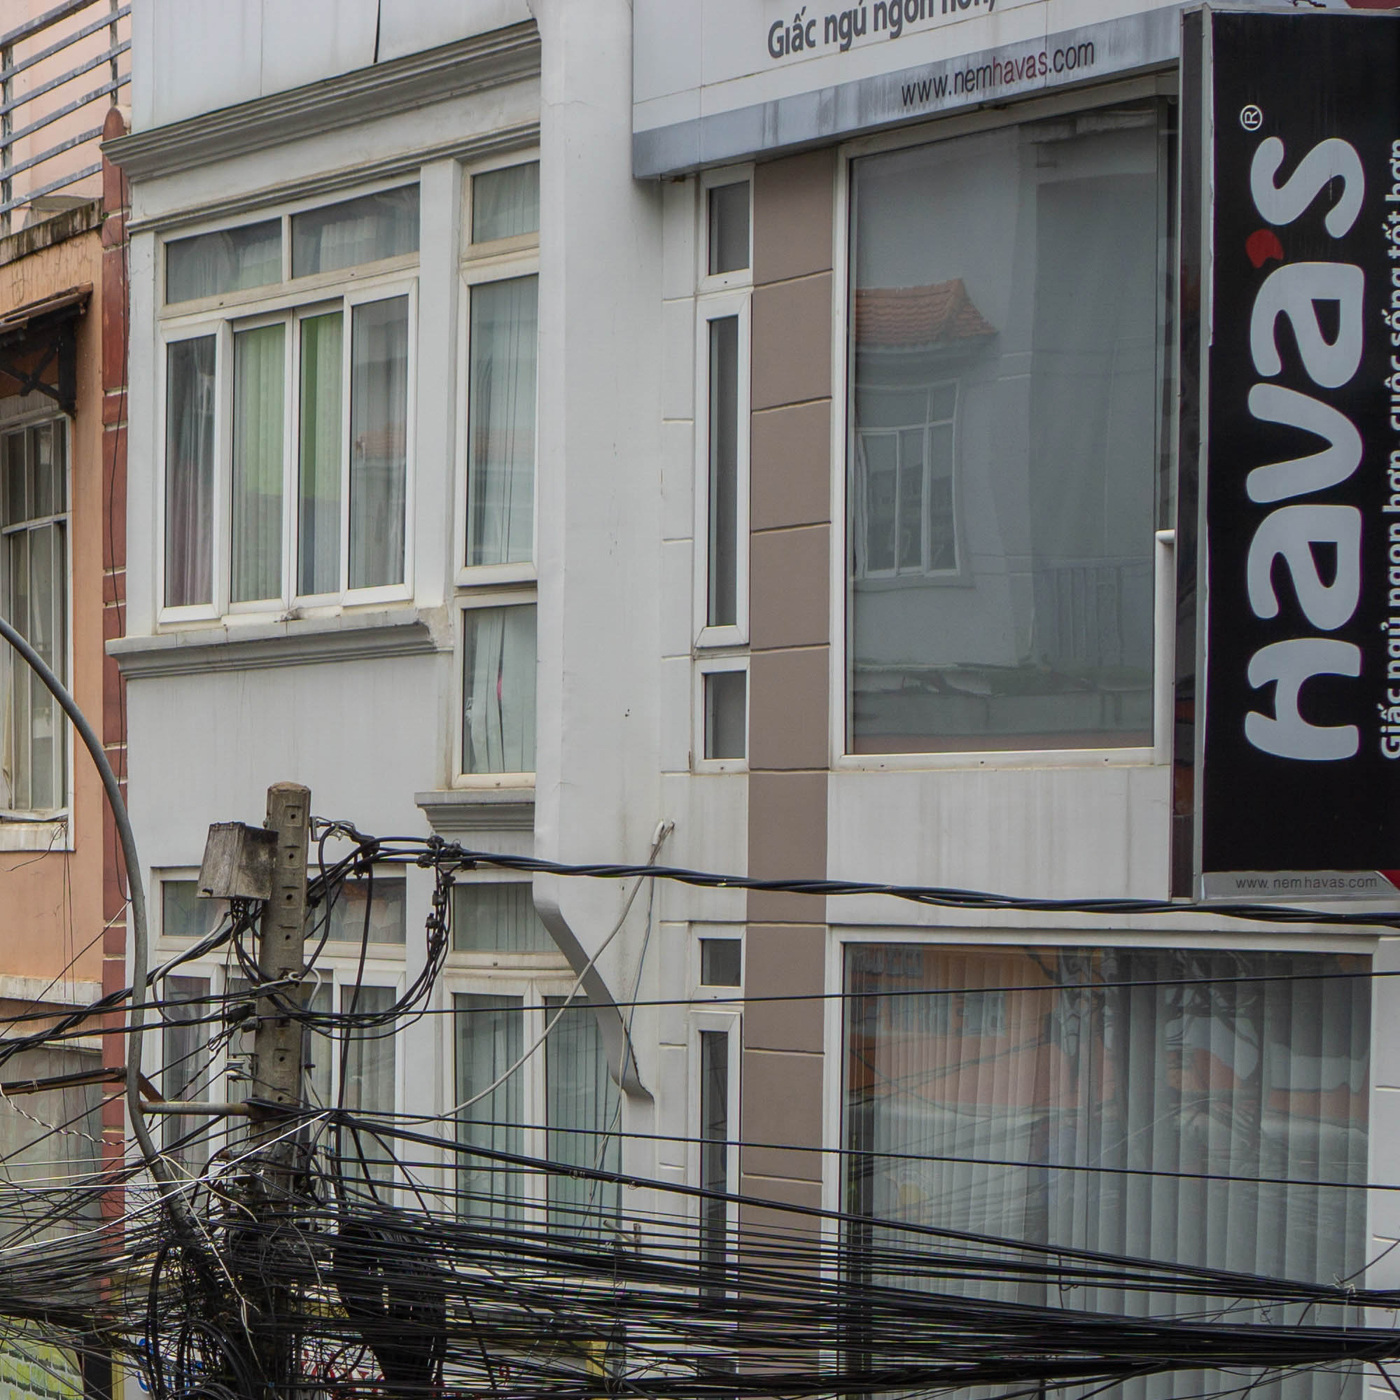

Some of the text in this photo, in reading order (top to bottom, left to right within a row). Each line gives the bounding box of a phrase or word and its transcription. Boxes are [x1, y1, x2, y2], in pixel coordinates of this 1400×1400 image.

[767, 6, 818, 59] Giấc
[900, 40, 1096, 107] www.nemhavas.com
[1235, 873, 1378, 891] www.nemhavas.com
